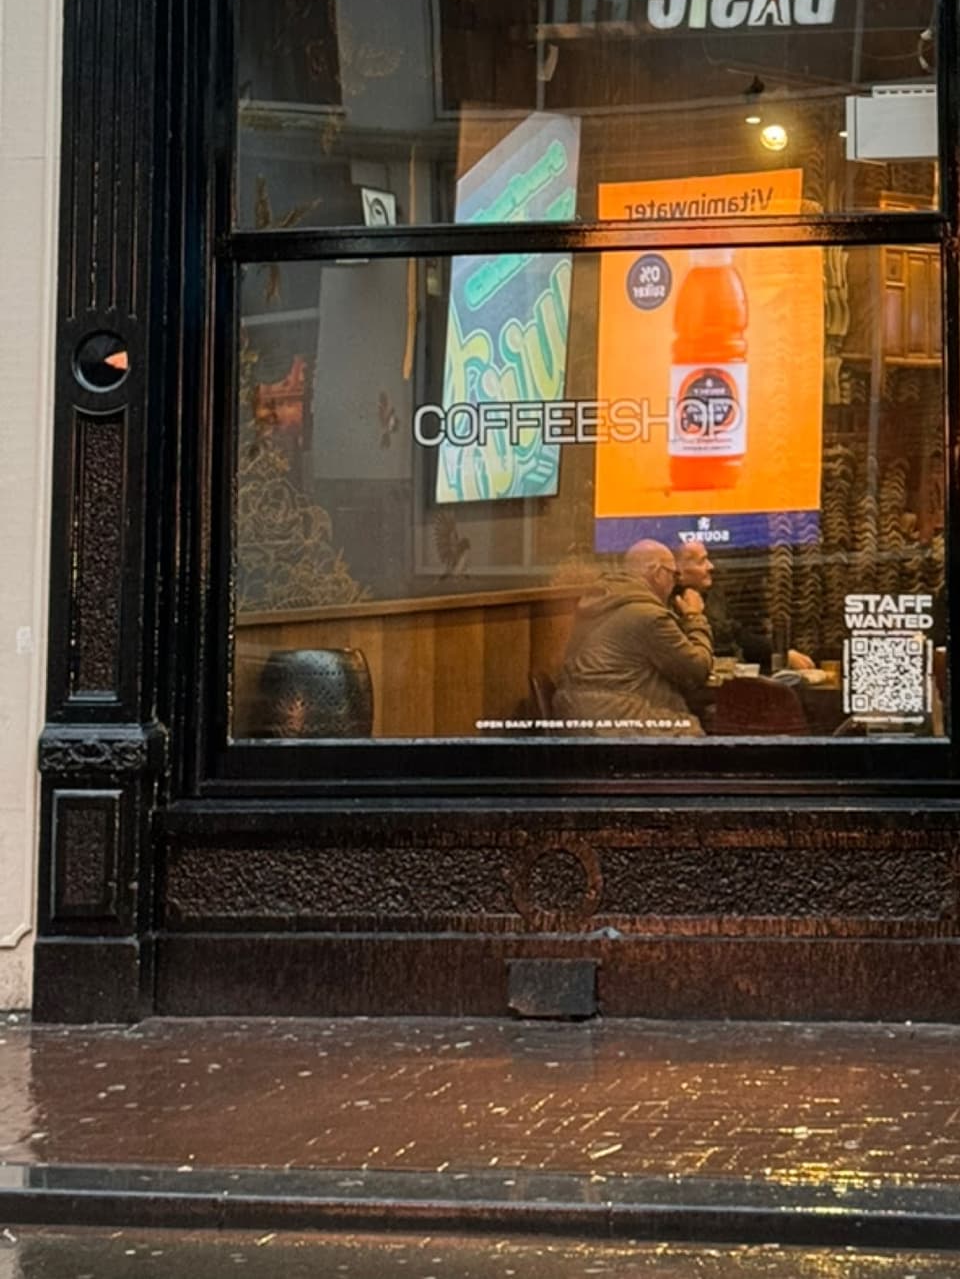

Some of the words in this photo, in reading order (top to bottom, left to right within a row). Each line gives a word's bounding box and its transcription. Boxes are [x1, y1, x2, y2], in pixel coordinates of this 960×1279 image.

[412, 396, 743, 447] COFFEESHOP
[844, 594, 933, 613] STAFF
[844, 614, 934, 629] WANTED
[475, 719, 504, 729] OPEN
[505, 719, 533, 729] DAILY
[535, 719, 564, 729] FROM
[595, 719, 613, 729] AM
[614, 719, 644, 729] UNTIL
[673, 719, 691, 729] AM
